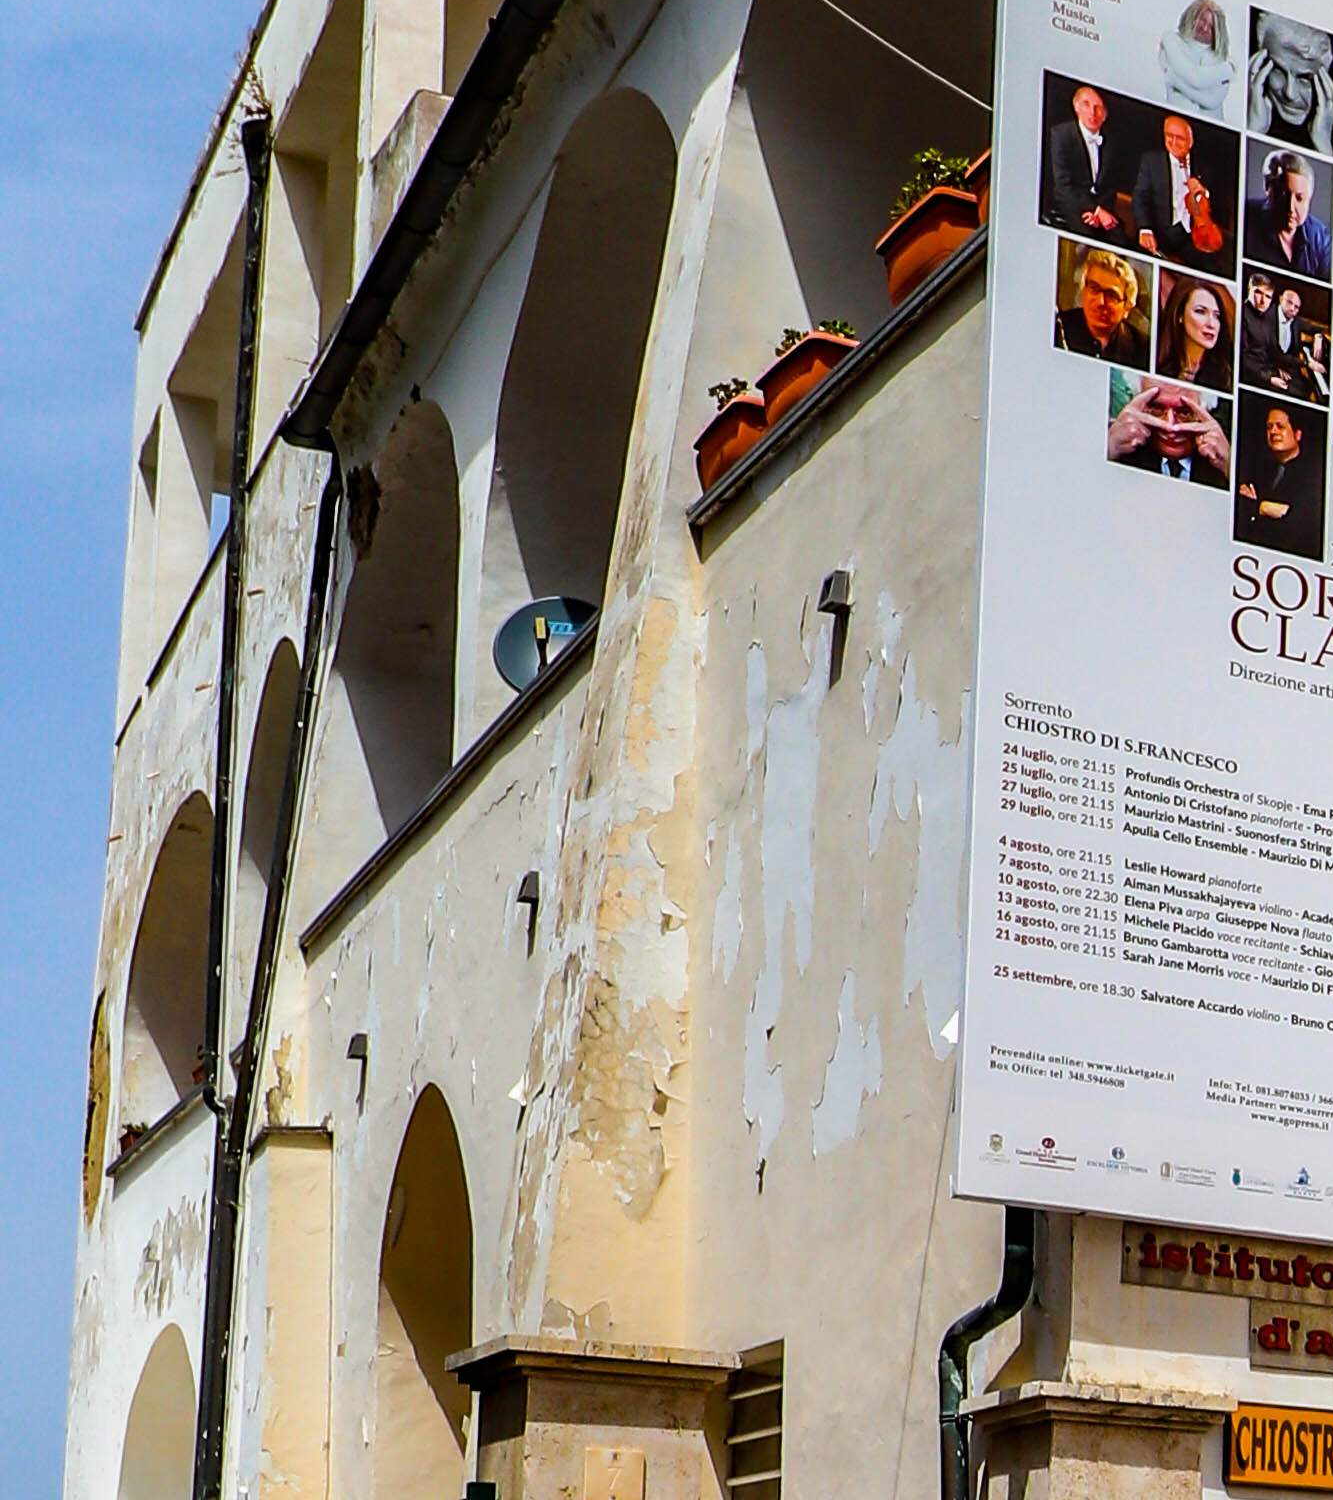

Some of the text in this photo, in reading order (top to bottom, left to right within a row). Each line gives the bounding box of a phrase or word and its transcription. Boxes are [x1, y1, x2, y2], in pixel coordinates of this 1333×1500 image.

[1052, 17, 1100, 42] Classica
[1053, 1, 1095, 25] Musica
[1004, 692, 1072, 719] Sorrento
[1229, 661, 1306, 693] Direzione
[1004, 714, 1238, 774] CHIOSTRO DI S.FRANCESCO
[1003, 742, 1018, 756] 24
[1021, 746, 1057, 766] luglio,
[1060, 756, 1079, 769] ore
[1082, 758, 1116, 776] 21.15
[1125, 767, 1181, 789] Profundis
[1183, 779, 1240, 801] Orchestra
[1242, 792, 1254, 804] of
[1257, 794, 1293, 812] Skopje
[1303, 803, 1326, 818] Ema
[1000, 797, 1016, 811] 29
[1019, 800, 1055, 820] luglio,
[1058, 812, 1077, 823] ore
[1080, 813, 1113, 830] 21.15
[1122, 821, 1160, 839] Apulia
[1162, 829, 1192, 845] Cello
[1194, 835, 1248, 856] Ensemble
[1259, 847, 1307, 867] Maurizio
[1309, 857, 1322, 870] Di
[1001, 779, 1017, 793] 27
[1020, 782, 1056, 802] luglio,
[1059, 793, 1078, 805] ore
[1081, 795, 1114, 812] 21.15
[1124, 803, 1175, 824] Maurizio
[1177, 814, 1225, 834] Mastrini
[1235, 825, 1297, 848] Suonosfera
[1300, 838, 1332, 857] String
[999, 835, 1262, 894] 4 agosto, ore 21.15 Leslie Howard pianoforte
[995, 927, 1010, 941] 21
[1013, 933, 1057, 950] agosto,
[1060, 941, 1080, 953] ore
[1082, 942, 1116, 959] 21.15
[1122, 949, 1155, 965] Sarah
[1157, 955, 1184, 970] Jane
[1187, 960, 1224, 977] Morris
[1227, 969, 1251, 982] voce
[1261, 973, 1309, 992] Maurizio
[1311, 981, 1324, 994] Di
[993, 965, 1009, 978] 25
[1012, 970, 1077, 991] settembre,
[1079, 982, 1099, 993] ore
[1103, 983, 1135, 999] 18.30
[1140, 989, 1195, 1009] Salvatore
[1197, 998, 1244, 1017] Accardo
[1246, 1007, 1281, 1022] violino
[1291, 1014, 1324, 1030] Bruno
